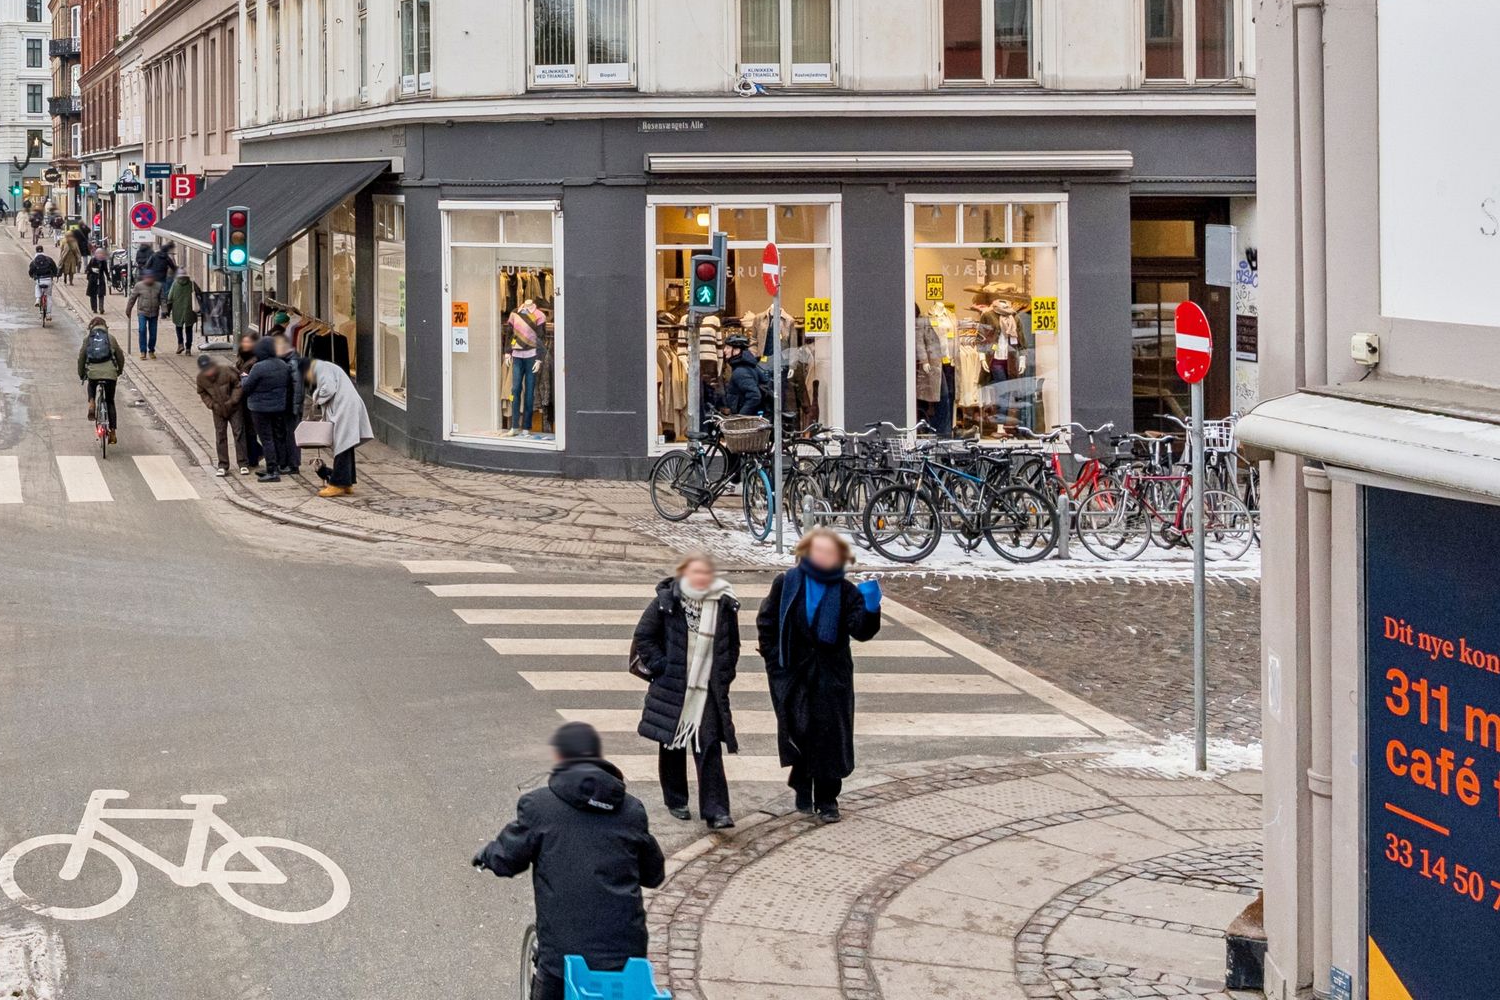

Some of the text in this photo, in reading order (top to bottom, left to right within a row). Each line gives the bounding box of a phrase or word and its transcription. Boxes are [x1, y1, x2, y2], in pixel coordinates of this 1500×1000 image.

[117, 183, 139, 191] Normal
[175, 177, 191, 196] B
[941, 263, 1031, 276] KJÆRULFF
[807, 303, 829, 312] SALE
[1034, 301, 1056, 310] SALE
[807, 317, 829, 330] -50%
[1034, 315, 1056, 329] -50%
[1383, 615, 1413, 647] Dit
[1418, 633, 1454, 662] nye
[1384, 667, 1449, 733] 311
[1385, 738, 1481, 807] café
[1384, 831, 1413, 869] 33
[1419, 847, 1449, 886] 14
[1453, 862, 1485, 902] 50
